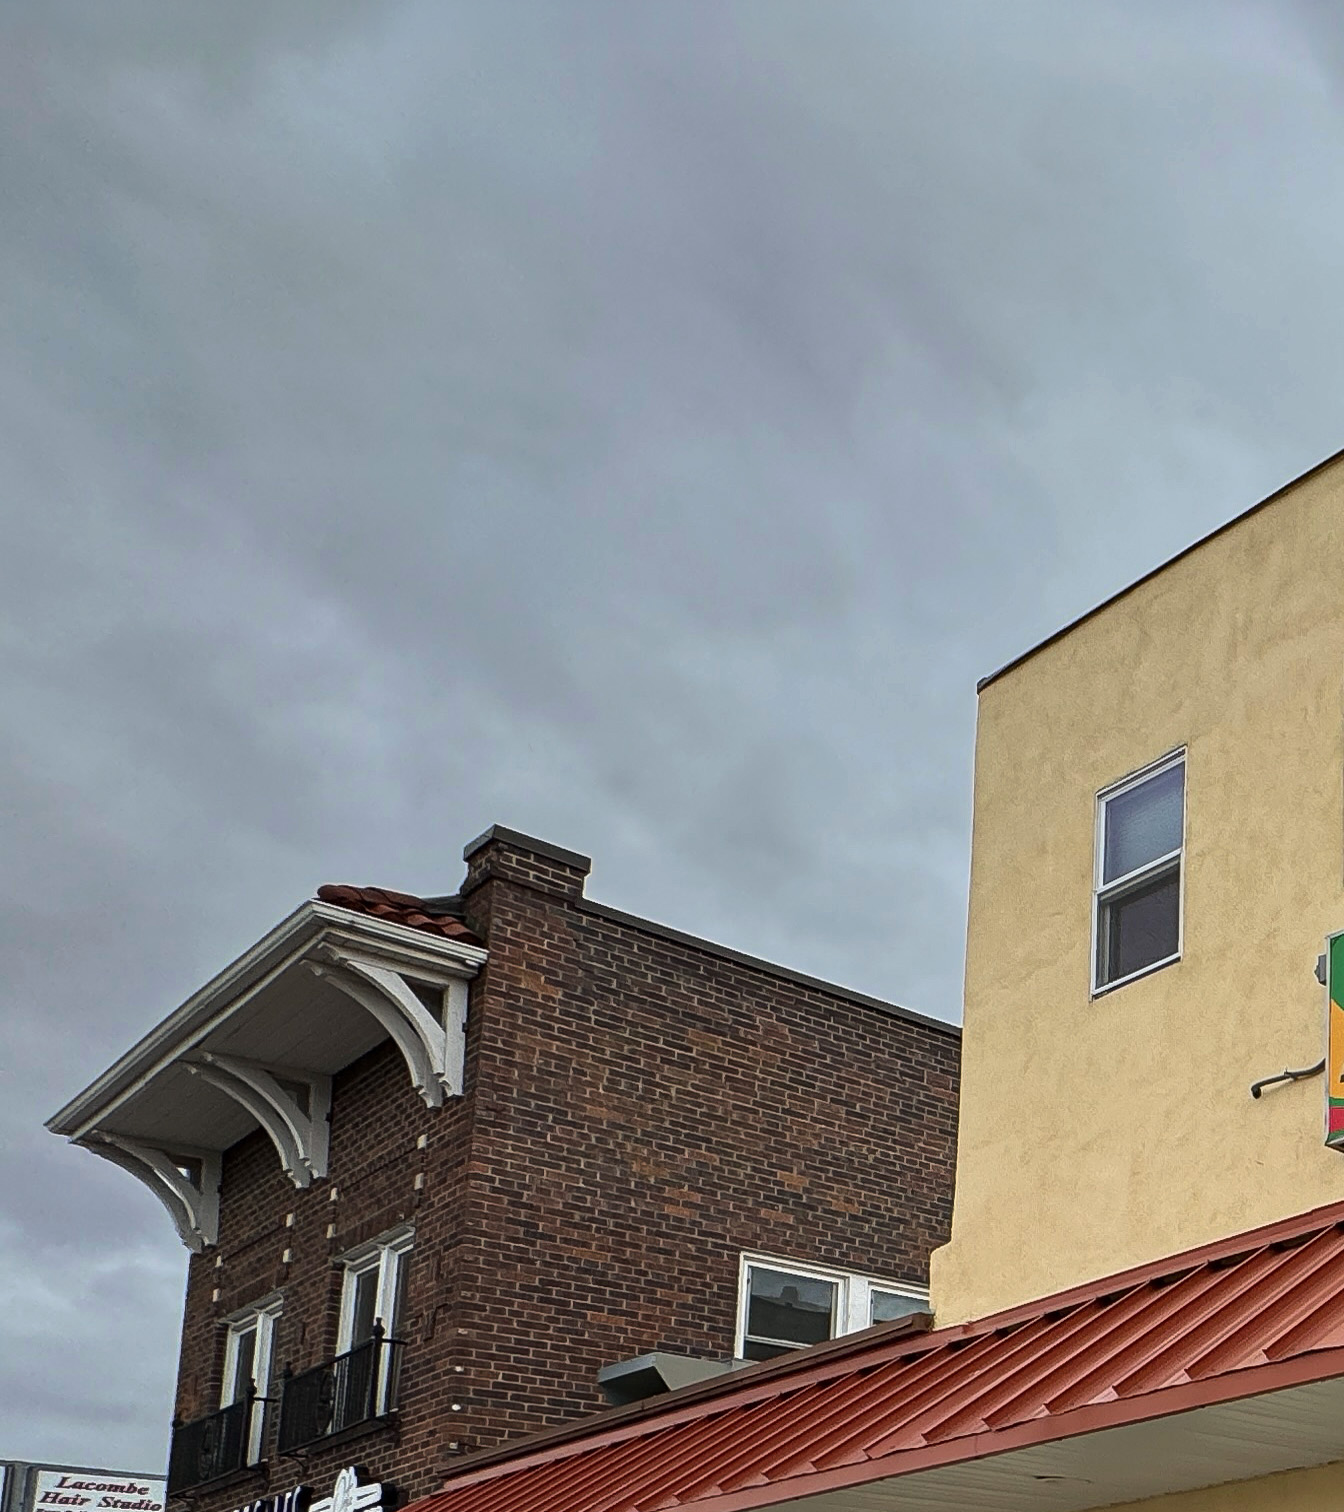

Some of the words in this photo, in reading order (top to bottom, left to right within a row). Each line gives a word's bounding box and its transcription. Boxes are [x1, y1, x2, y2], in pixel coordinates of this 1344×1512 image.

[55, 1476, 150, 1496] Lacombe
[37, 1491, 92, 1507] Hair
[96, 1496, 163, 1512] Studio
